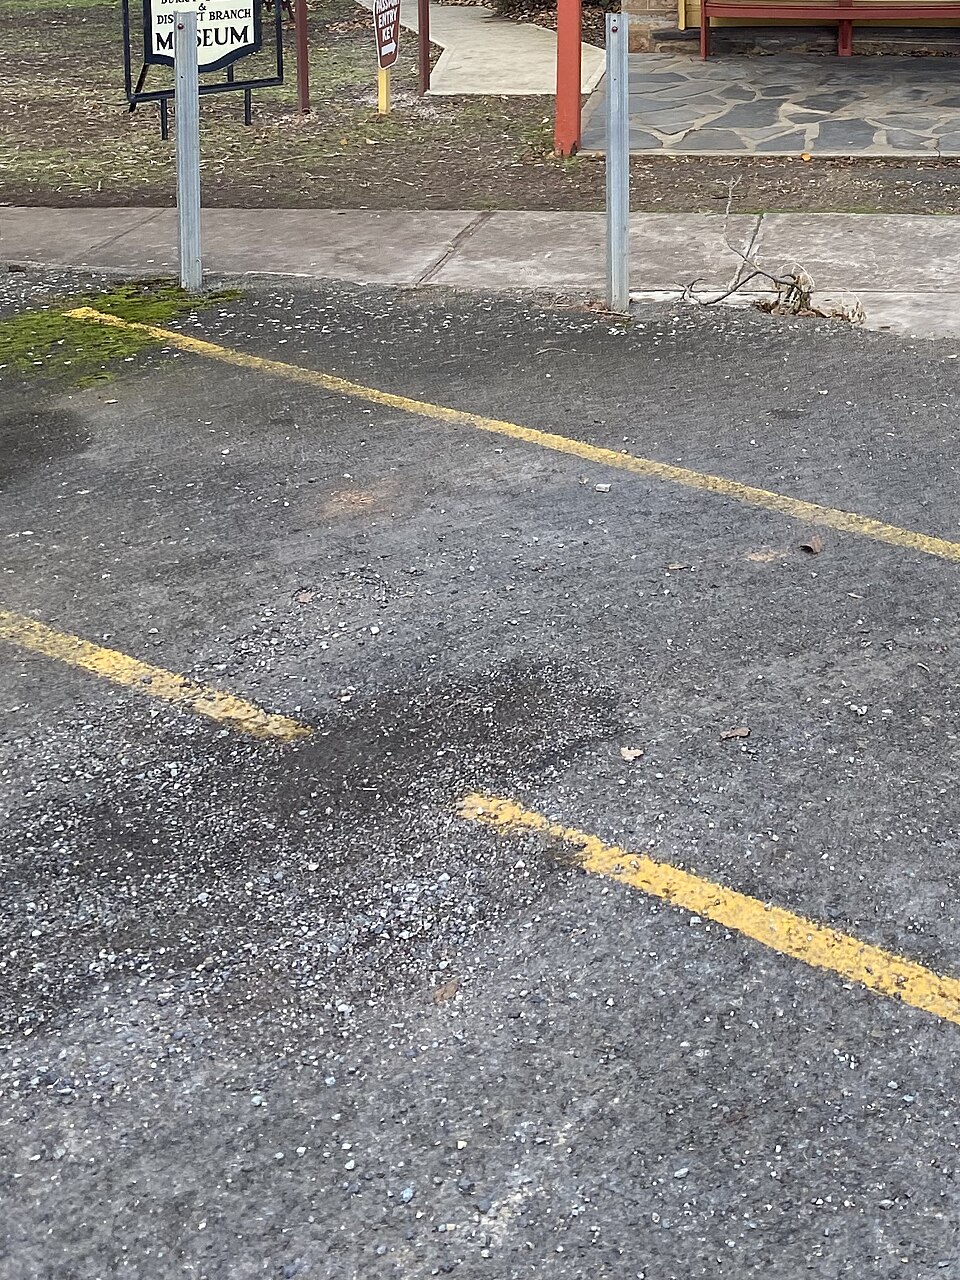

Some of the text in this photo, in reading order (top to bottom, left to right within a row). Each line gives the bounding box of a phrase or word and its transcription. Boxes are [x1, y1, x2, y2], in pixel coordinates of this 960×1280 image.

[198, 2, 207, 11] &
[156, 8, 252, 25] DIST BRANCH
[378, 7, 398, 29] ENTRY
[382, 23, 395, 43] KEY
